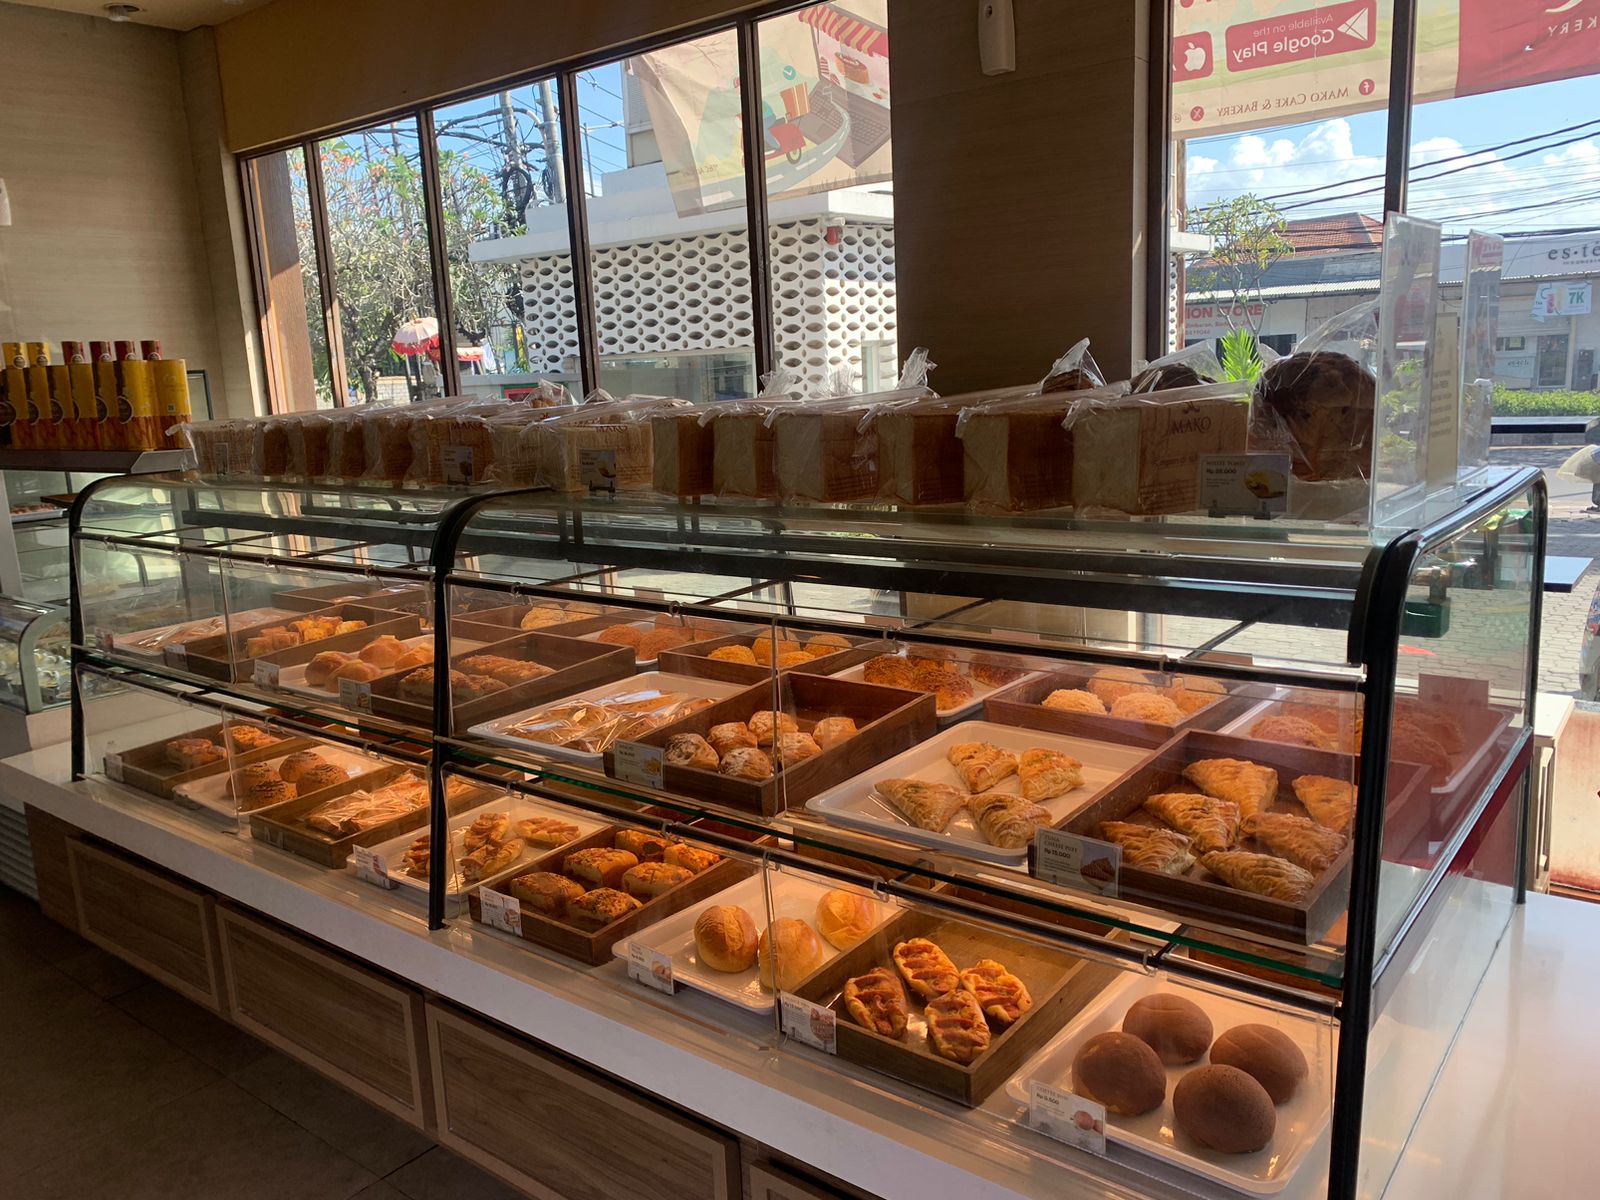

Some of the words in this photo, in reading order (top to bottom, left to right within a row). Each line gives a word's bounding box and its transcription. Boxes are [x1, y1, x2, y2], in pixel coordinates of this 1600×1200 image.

[1569, 291, 1584, 304] 7K
[1186, 306, 1213, 319] ION
[1170, 416, 1212, 434] MAKO
